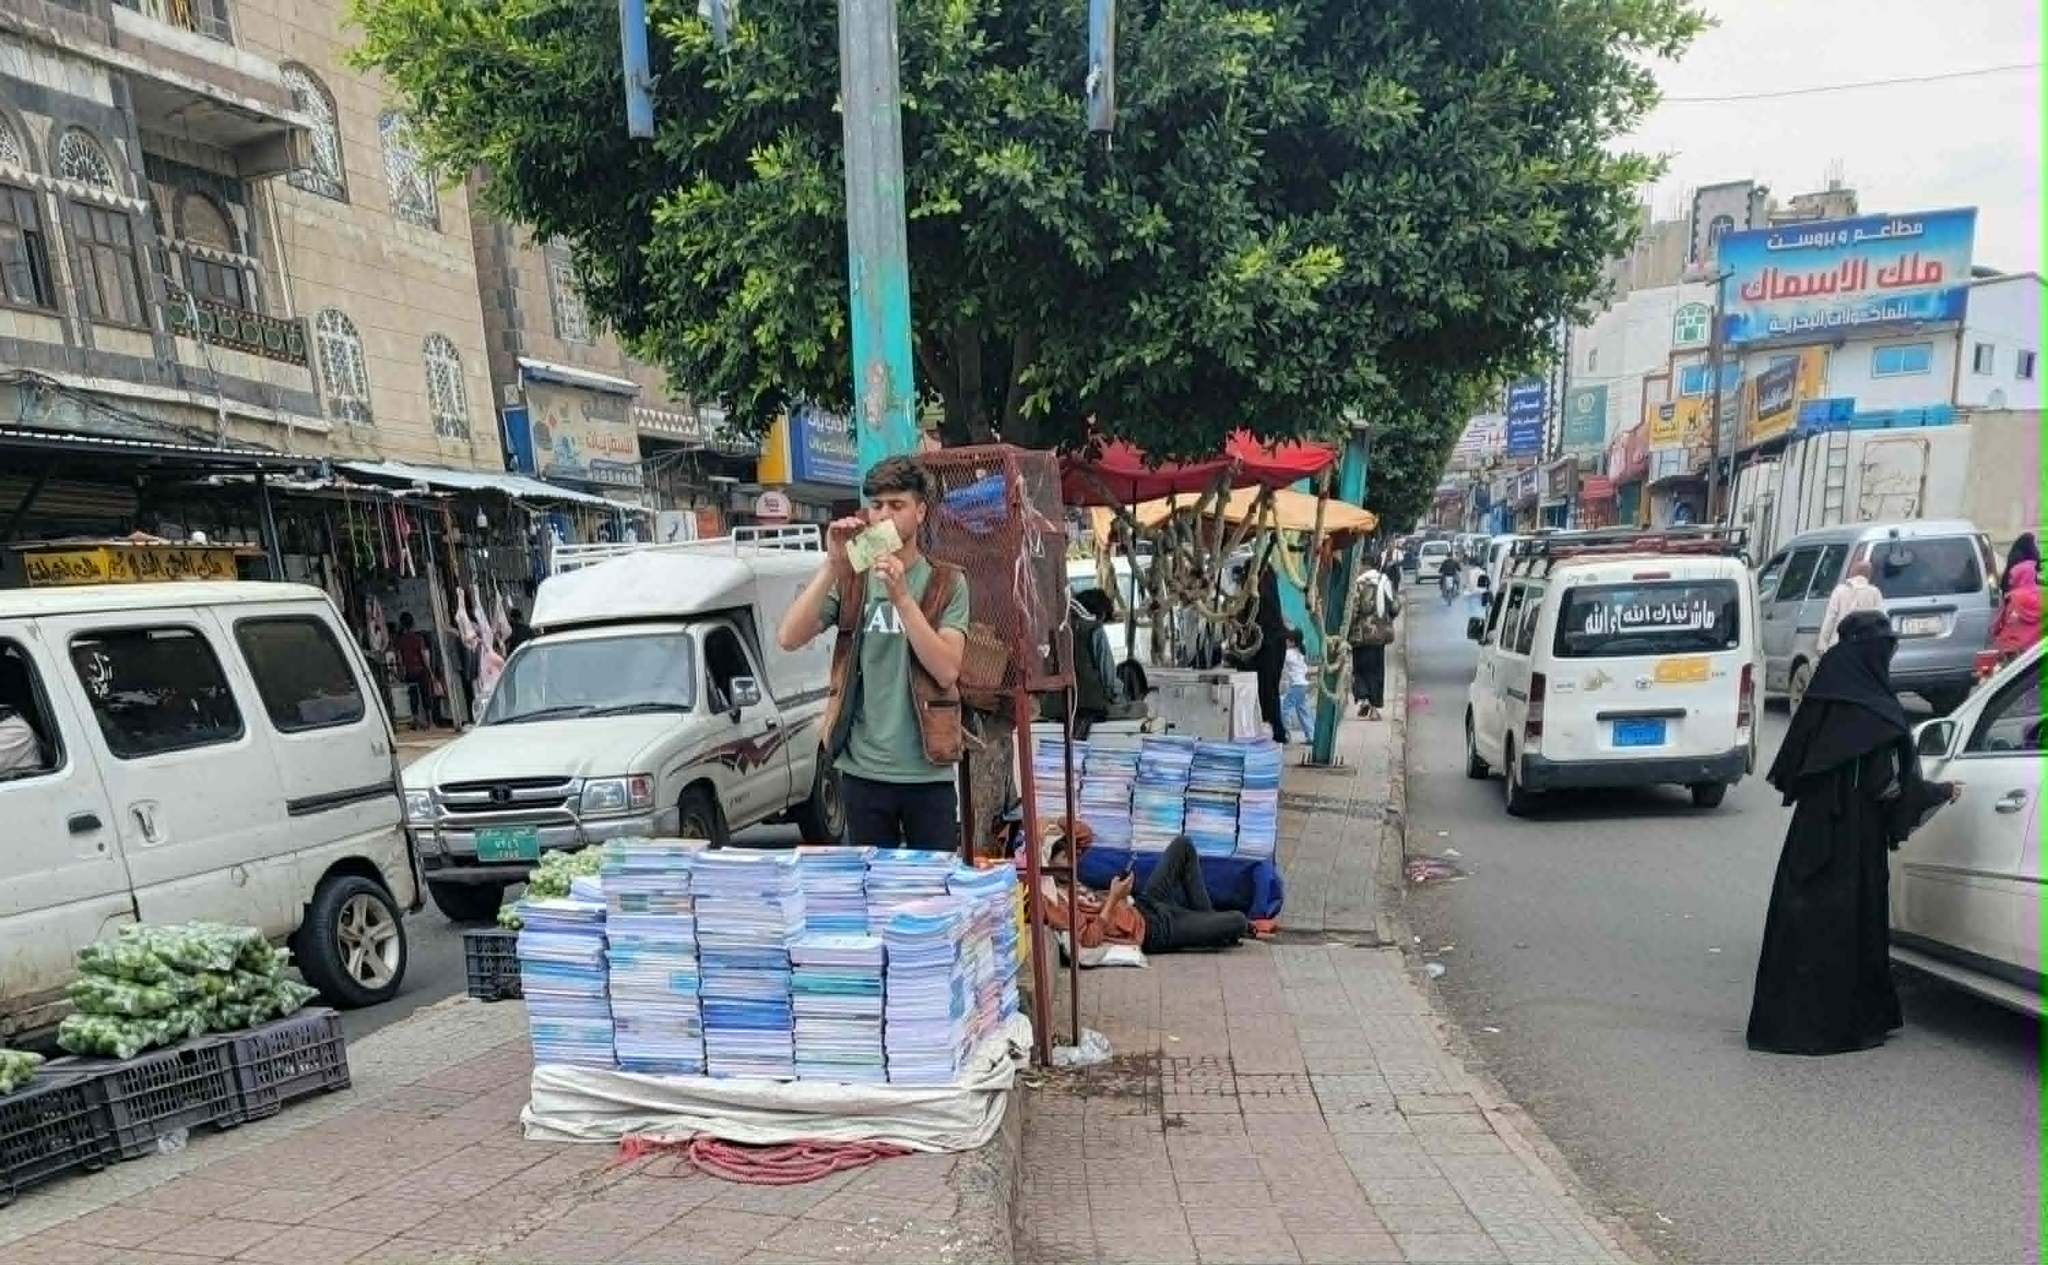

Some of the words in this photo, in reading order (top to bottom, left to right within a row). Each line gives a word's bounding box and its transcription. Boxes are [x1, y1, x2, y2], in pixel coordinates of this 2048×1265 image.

[1766, 231, 1836, 251] بروست
[1852, 219, 1924, 243] مطاعم
[1740, 257, 1869, 303] الاسماك
[1876, 251, 1944, 287] ملك
[1585, 604, 1608, 635] الله
[1623, 604, 1651, 625] الله
[1652, 602, 1688, 624] تبارك
